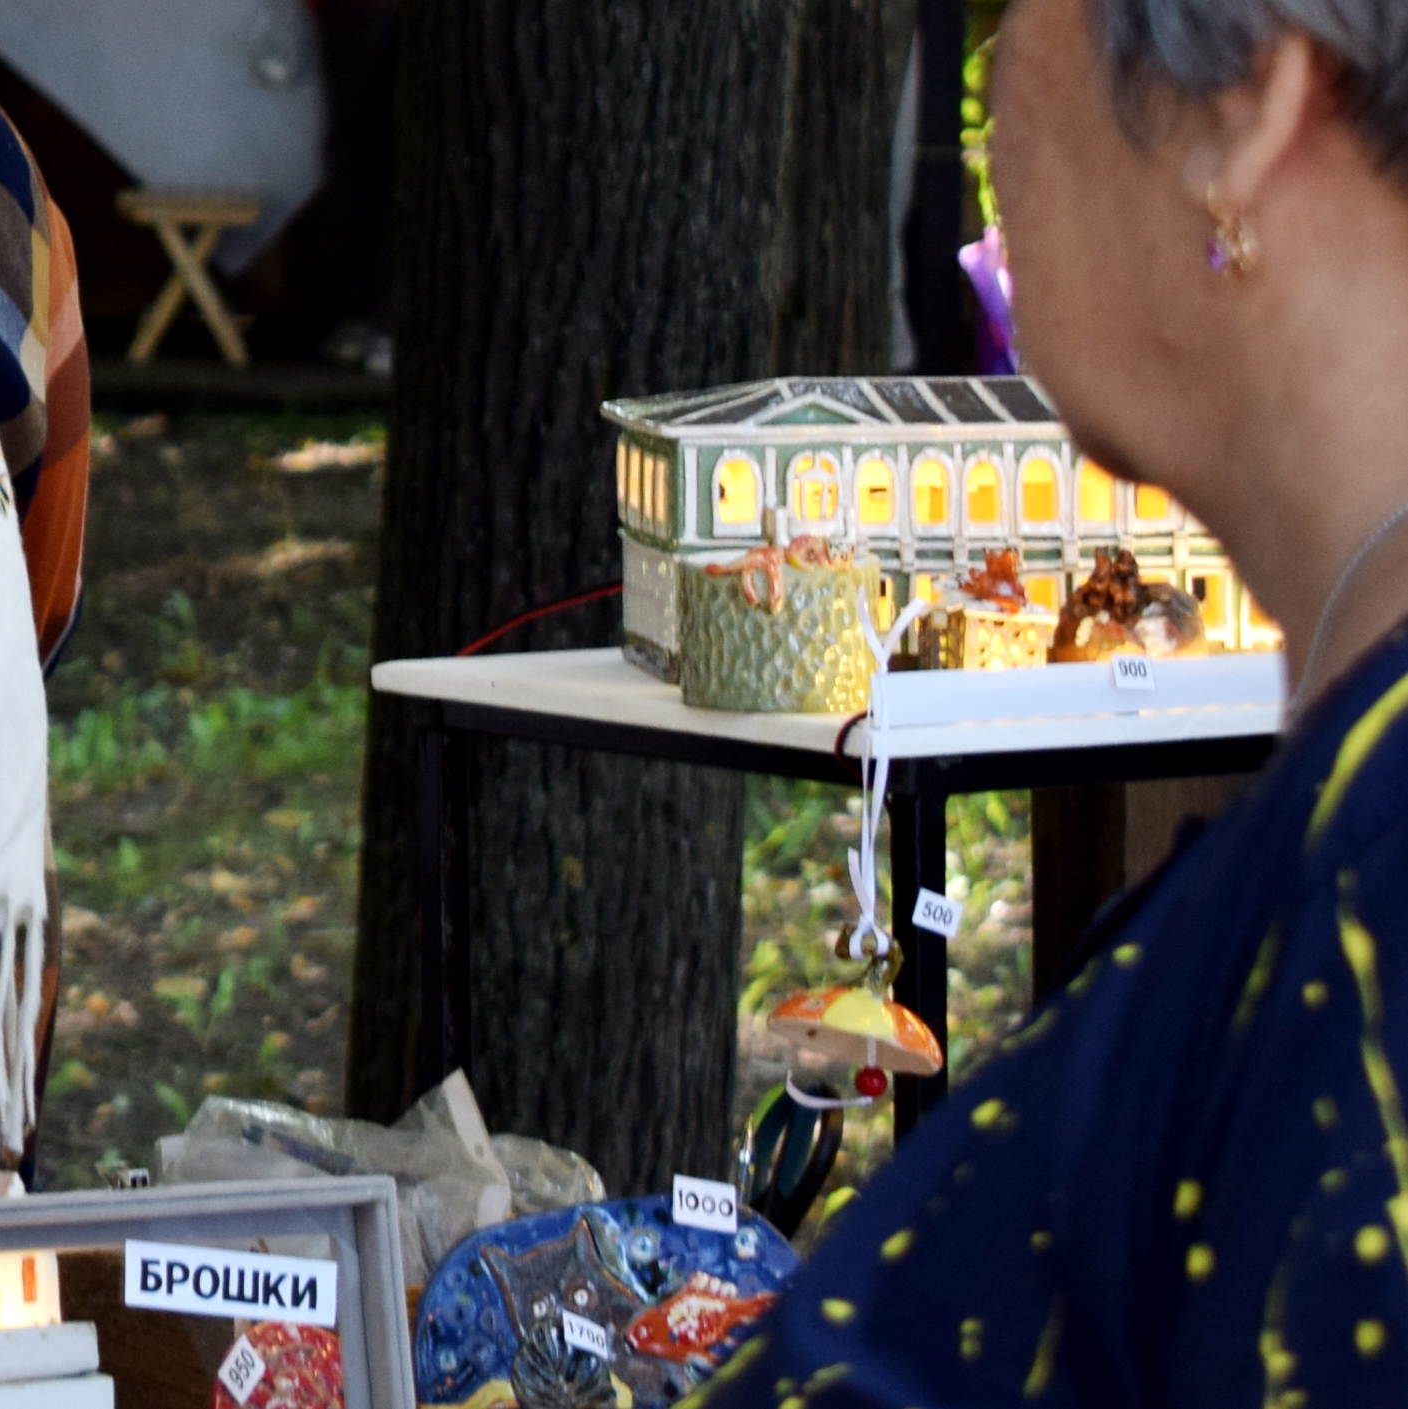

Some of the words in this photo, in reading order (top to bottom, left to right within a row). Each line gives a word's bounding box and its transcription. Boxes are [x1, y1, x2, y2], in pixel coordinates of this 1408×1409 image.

[1118, 661, 1147, 678] 900
[921, 900, 952, 926] 500
[677, 1187, 733, 1218] 1000
[138, 1258, 320, 1311] БРОШКИ
[567, 1318, 605, 1350] 1700
[227, 1349, 253, 1391] 950
